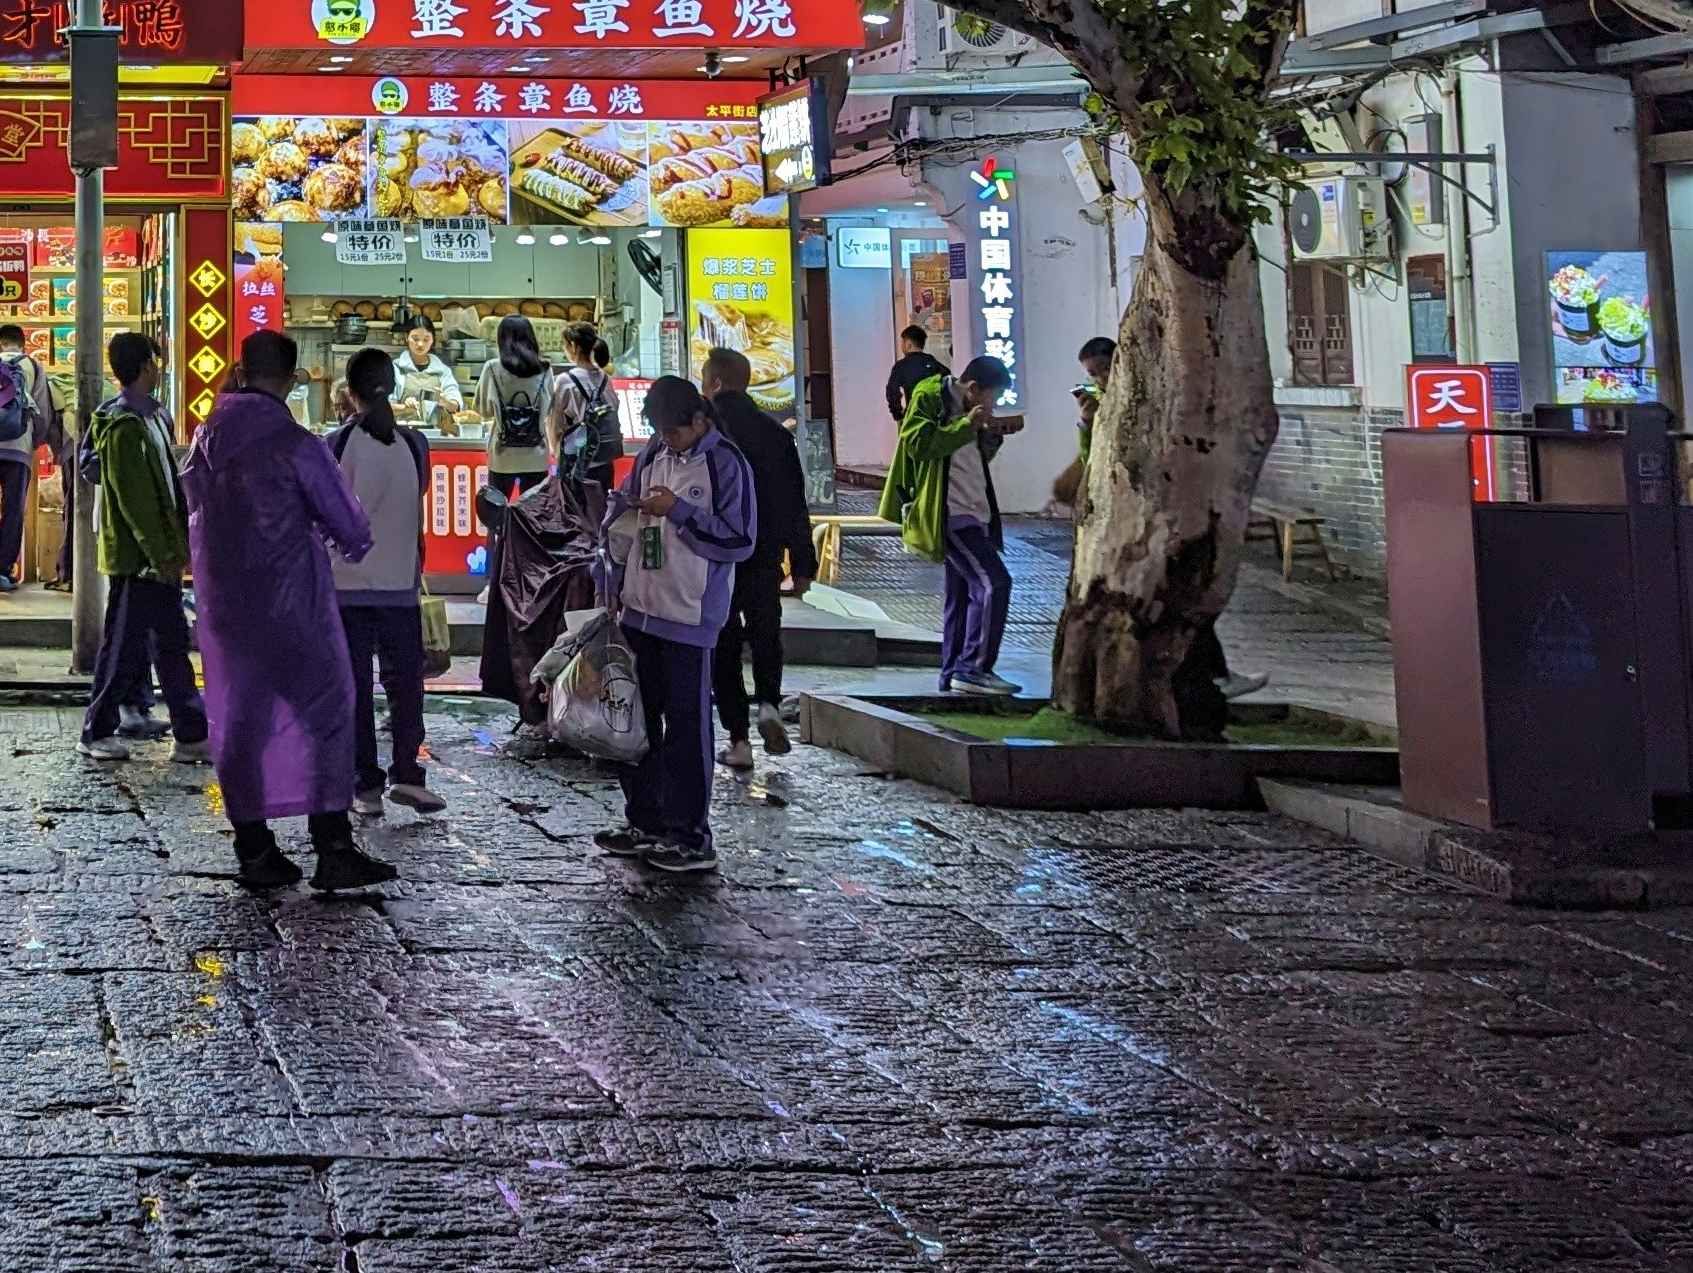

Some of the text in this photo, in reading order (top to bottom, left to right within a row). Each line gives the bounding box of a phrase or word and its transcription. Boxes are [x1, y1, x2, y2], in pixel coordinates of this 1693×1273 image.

[427, 81, 644, 115] 整条章鱼烧
[705, 104, 758, 118] 太平街店
[348, 234, 392, 251] 特价
[433, 232, 478, 249] 特价
[703, 257, 777, 276] 爆浆芝士
[242, 280, 276, 297] 拉丝
[712, 281, 768, 301] 榴莲饼
[248, 304, 269, 325] 芝
[979, 205, 1019, 406] 中国体育彩
[1424, 379, 1479, 428] 天
